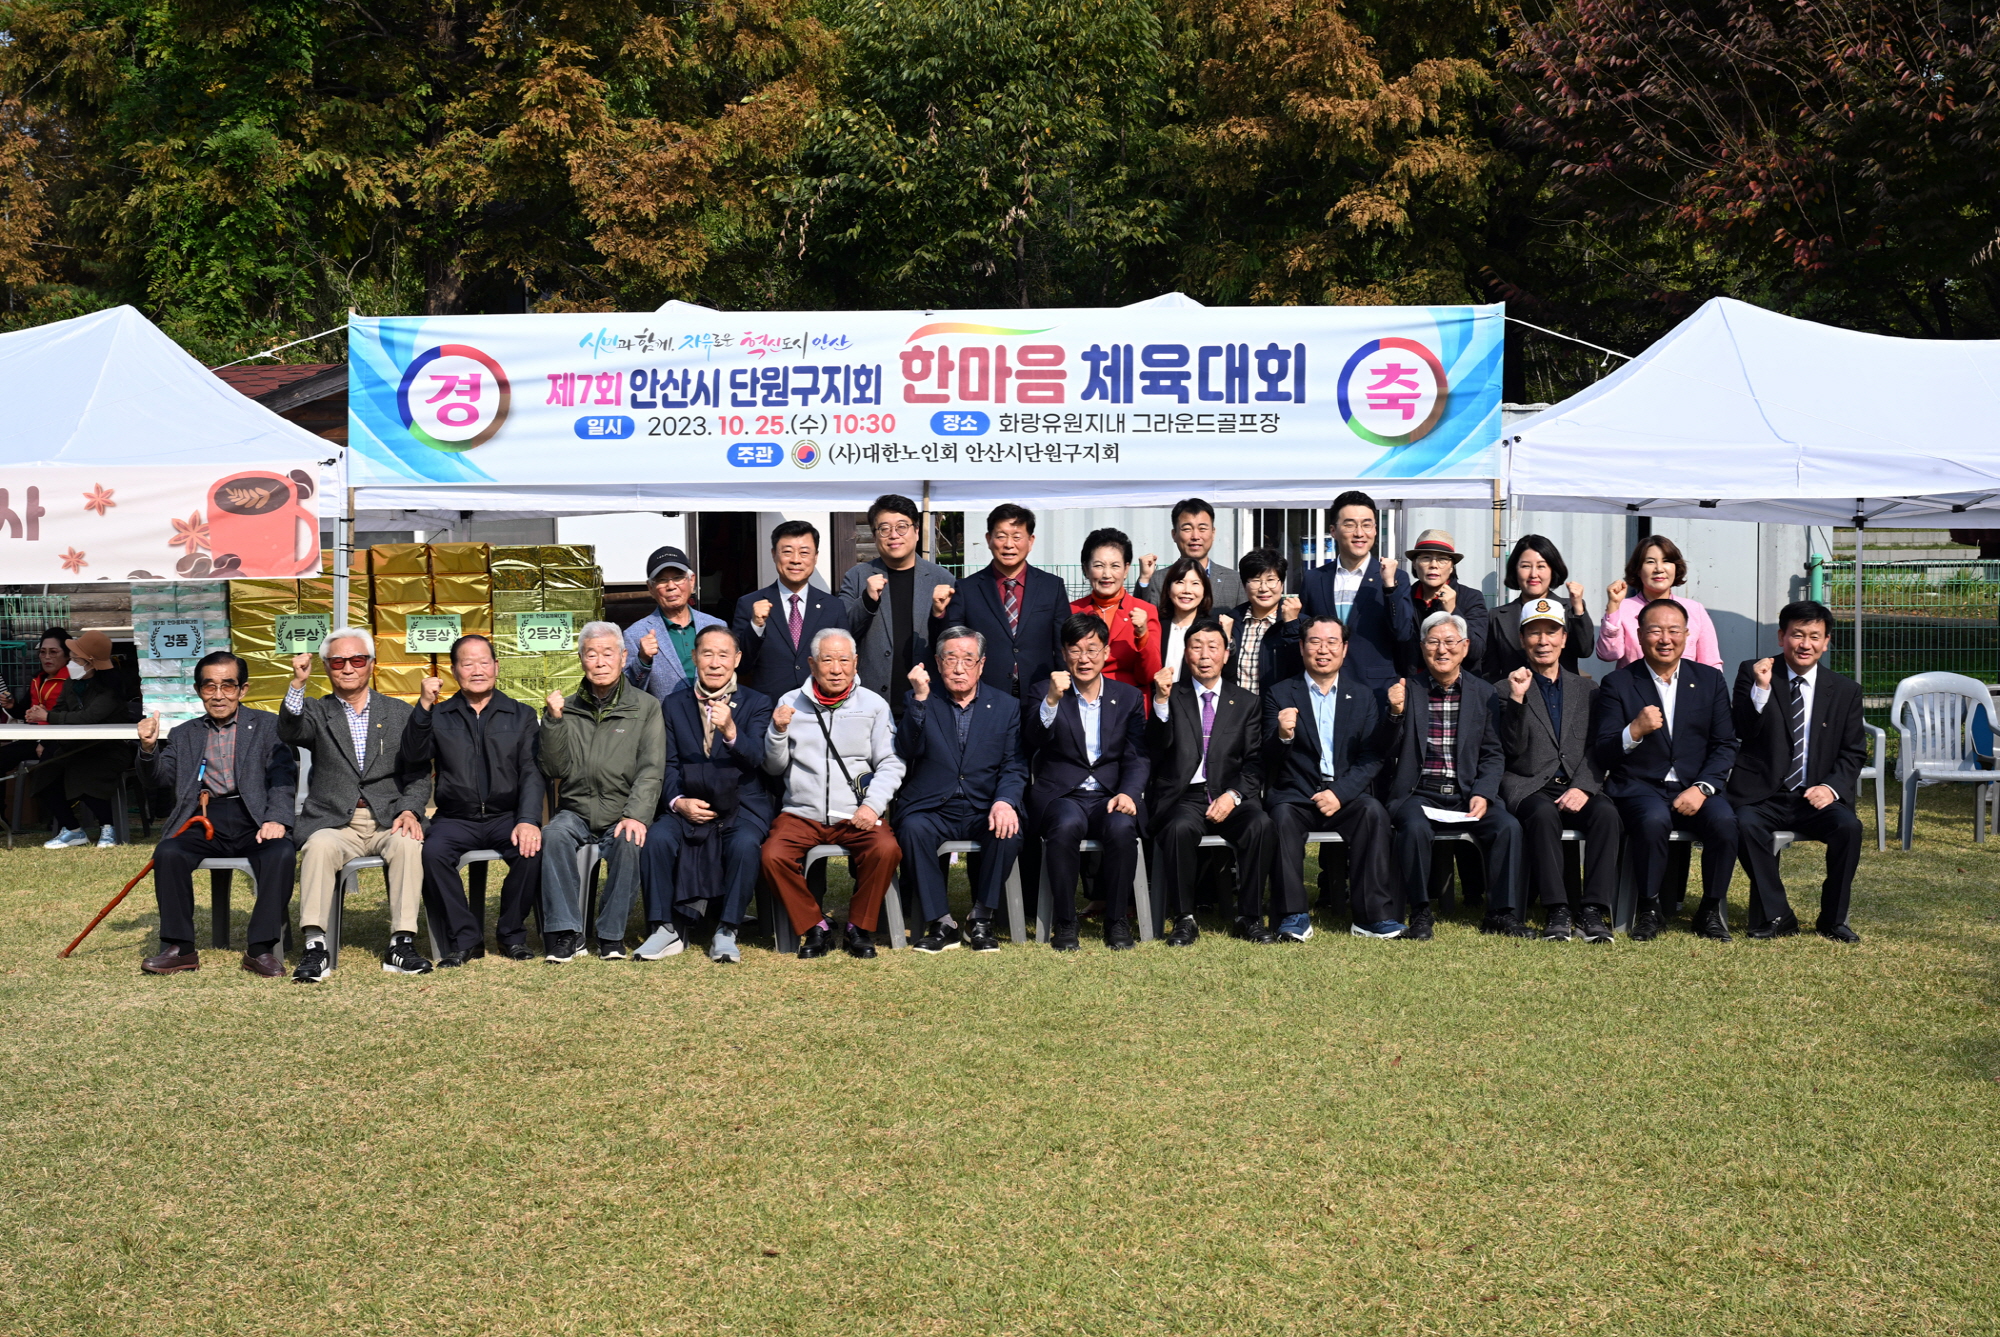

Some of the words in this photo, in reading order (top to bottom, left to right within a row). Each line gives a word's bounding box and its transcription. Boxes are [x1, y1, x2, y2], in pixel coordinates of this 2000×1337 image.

[740, 331, 808, 360] 혁신도시
[811, 333, 854, 351] 안산
[546, 371, 623, 407] 제7회
[629, 367, 721, 410] 안산시
[729, 363, 882, 408] 단원구지회
[899, 342, 1068, 404] 한마음
[1080, 341, 1307, 405] 체육대회
[425, 373, 482, 427] 경
[1366, 362, 1423, 420] 축
[587, 418, 622, 436] 일시
[647, 415, 712, 437] 2023.
[718, 415, 749, 436] 10.
[833, 413, 896, 434] 10:30
[942, 414, 978, 432] 장소
[999, 413, 1126, 434] 화랑유원지내
[1131, 412, 1280, 434] 그라운드골프장
[737, 446, 773, 464] 주관
[828, 442, 958, 465] (사)대한노인회
[965, 442, 1120, 464] 안산시단원구지회
[163, 633, 189, 648] 경품
[285, 628, 319, 642] 4등상
[417, 629, 450, 642] 3등상
[527, 626, 562, 640] 2등상
